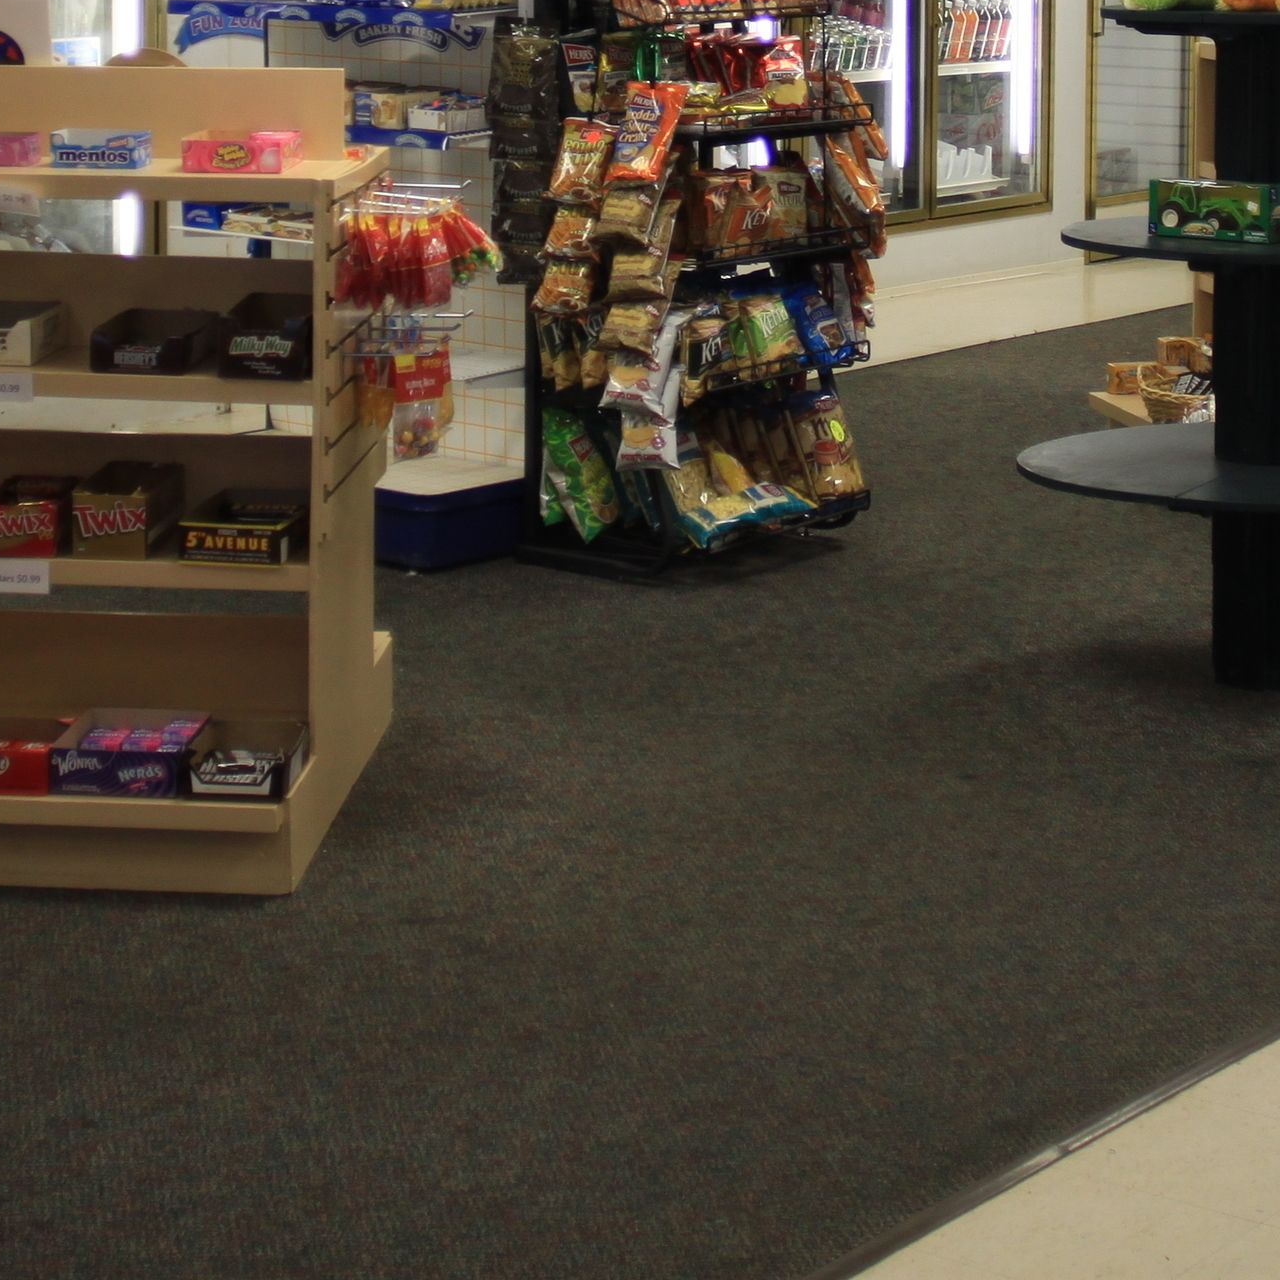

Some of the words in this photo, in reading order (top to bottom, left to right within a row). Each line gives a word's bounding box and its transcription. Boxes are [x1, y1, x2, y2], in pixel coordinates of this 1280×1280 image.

[190, 15, 224, 37] FUN
[358, 23, 401, 41] BAKERY
[58, 149, 128, 163] mentos
[73, 502, 146, 538] Twix
[204, 535, 270, 552] AVENUE
[16, 574, 41, 585] $0.99
[52, 751, 102, 776] WONKA
